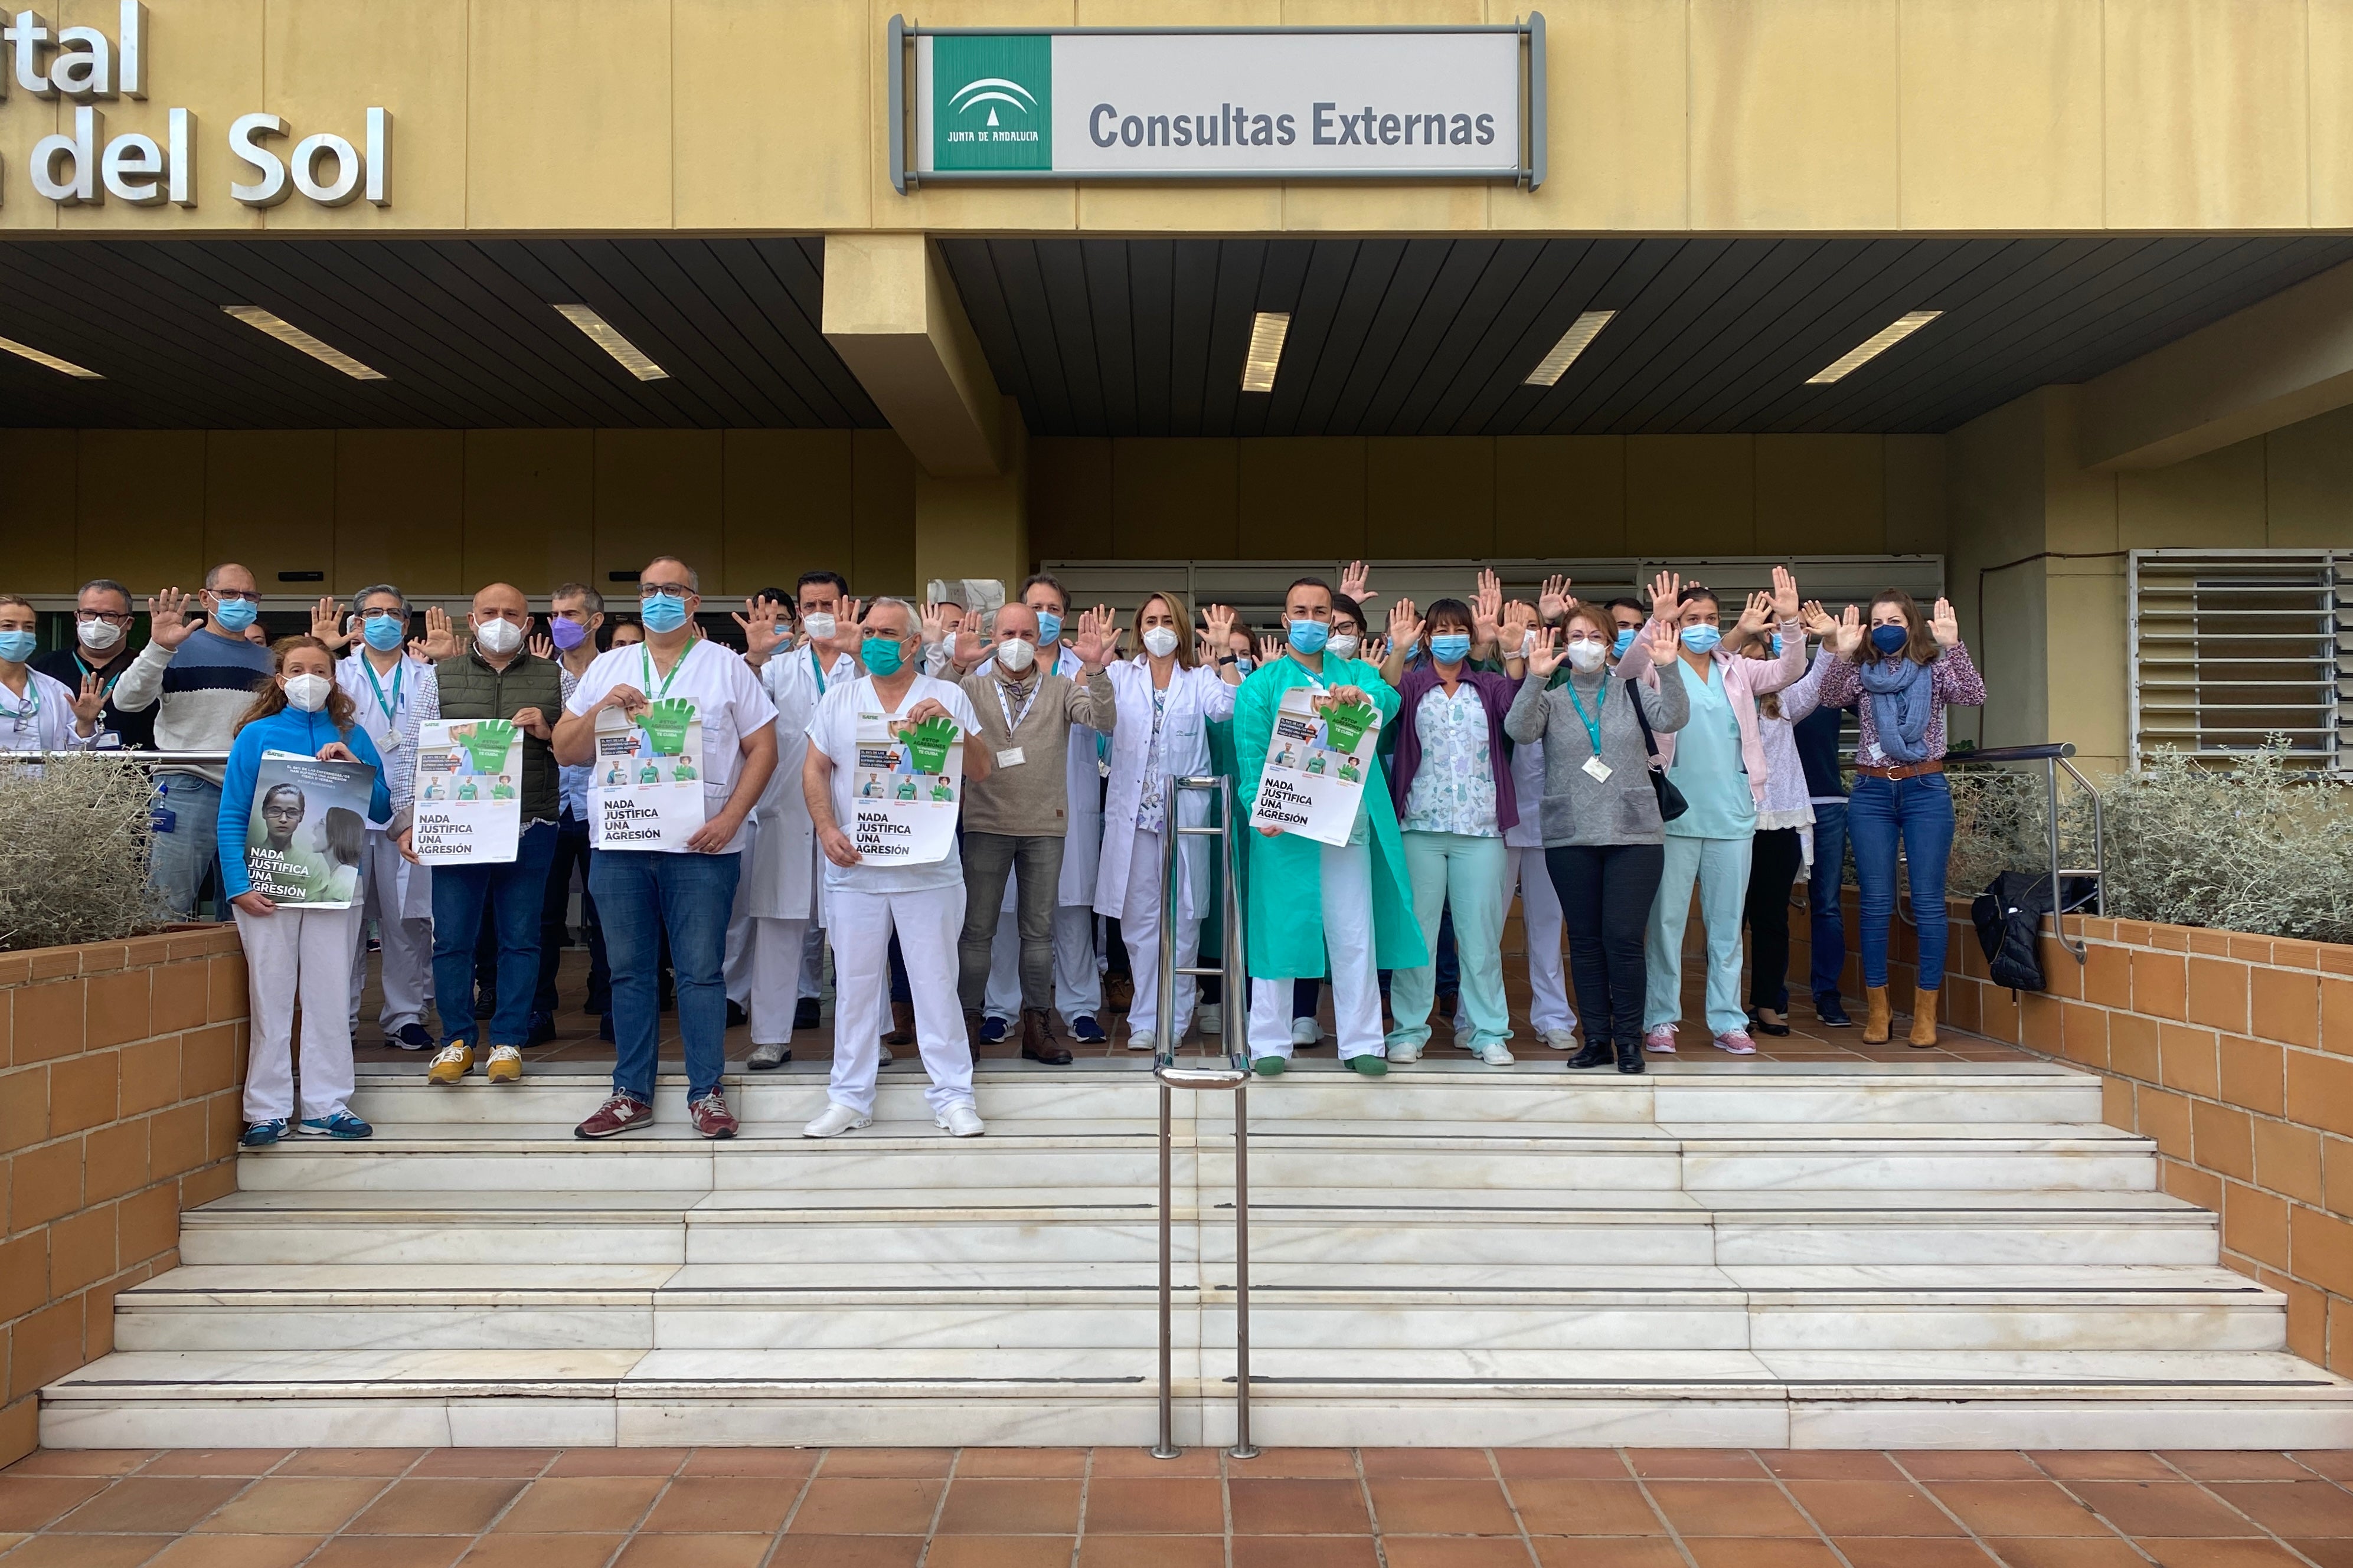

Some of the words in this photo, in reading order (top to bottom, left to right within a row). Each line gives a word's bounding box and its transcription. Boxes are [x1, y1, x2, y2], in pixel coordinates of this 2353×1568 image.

[0, 0, 148, 100] tal
[1090, 103, 1296, 148] Consultas
[1313, 102, 1495, 145] Externas
[947, 132, 974, 142] JUNTA
[978, 132, 988, 142] DE
[993, 132, 1038, 142] ANDALUCIA
[30, 106, 197, 208] del
[228, 107, 392, 208] Sol
[1332, 719, 1362, 731] AGRESIONES
[913, 741, 945, 749] AGRESIONES
[1265, 778, 1293, 791] NADA
[1262, 788, 1312, 806] JUSTIFICA
[604, 800, 635, 809] NADA
[1260, 798, 1282, 810] UNA
[419, 814, 450, 823] NADA
[604, 808, 658, 820] JUSTIFICA
[858, 813, 888, 822] NADA
[1257, 810, 1308, 825] AGRESIÓN
[419, 825, 472, 833] JUSTIFICA
[604, 821, 629, 830] UNA
[857, 824, 911, 834] JUSTIFICA
[419, 836, 442, 844] UNA
[604, 828, 661, 840] AGRESIÓN
[857, 834, 880, 843] UNA
[251, 847, 284, 860] NADA
[417, 843, 472, 854] AGRESIÓN
[856, 844, 909, 855] AGRESIÓN
[248, 859, 309, 875] JUSTIFICA
[248, 870, 272, 882] UNA
[250, 882, 306, 897] GRESIÓN
